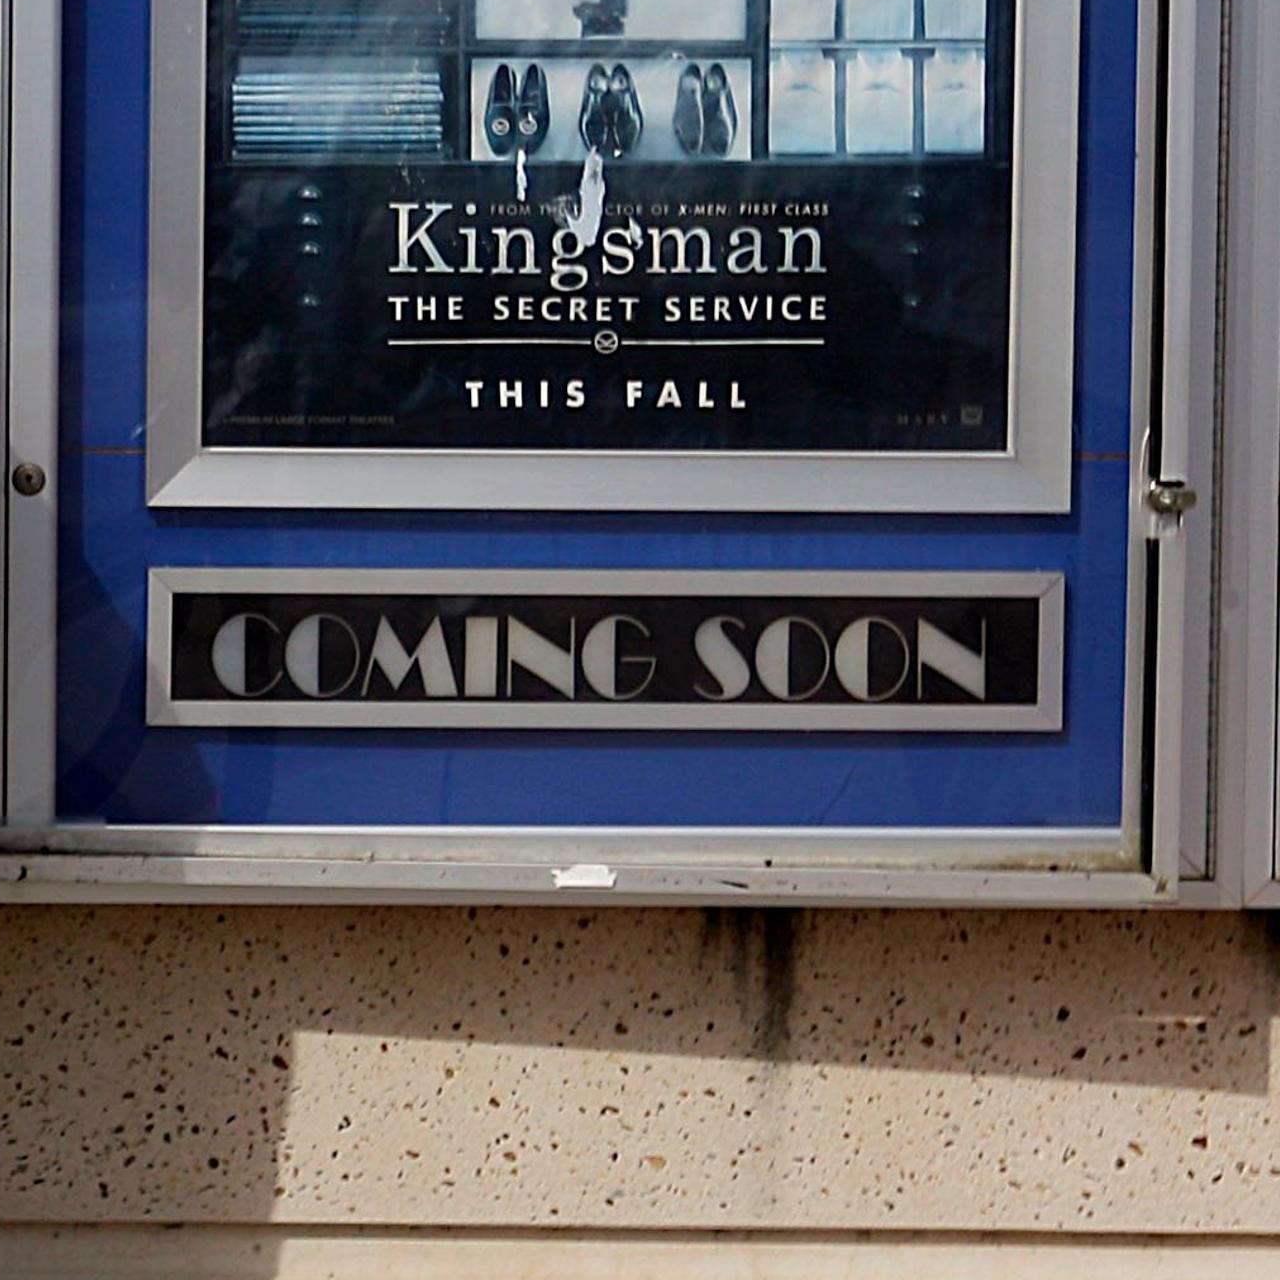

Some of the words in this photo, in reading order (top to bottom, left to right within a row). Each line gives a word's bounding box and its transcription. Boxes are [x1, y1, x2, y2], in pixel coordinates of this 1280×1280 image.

[491, 203, 531, 217] FROM
[651, 204, 669, 216] OF
[740, 203, 777, 217] FIRST
[785, 203, 829, 217] CLASS
[387, 202, 829, 292] Kingsman
[387, 295, 465, 322] THE
[493, 295, 640, 322] SECRET
[665, 295, 827, 322] SERVICE
[465, 379, 586, 409] THIS
[625, 380, 747, 409] FALL
[211, 612, 657, 702] COMING
[693, 615, 987, 704] SOON
